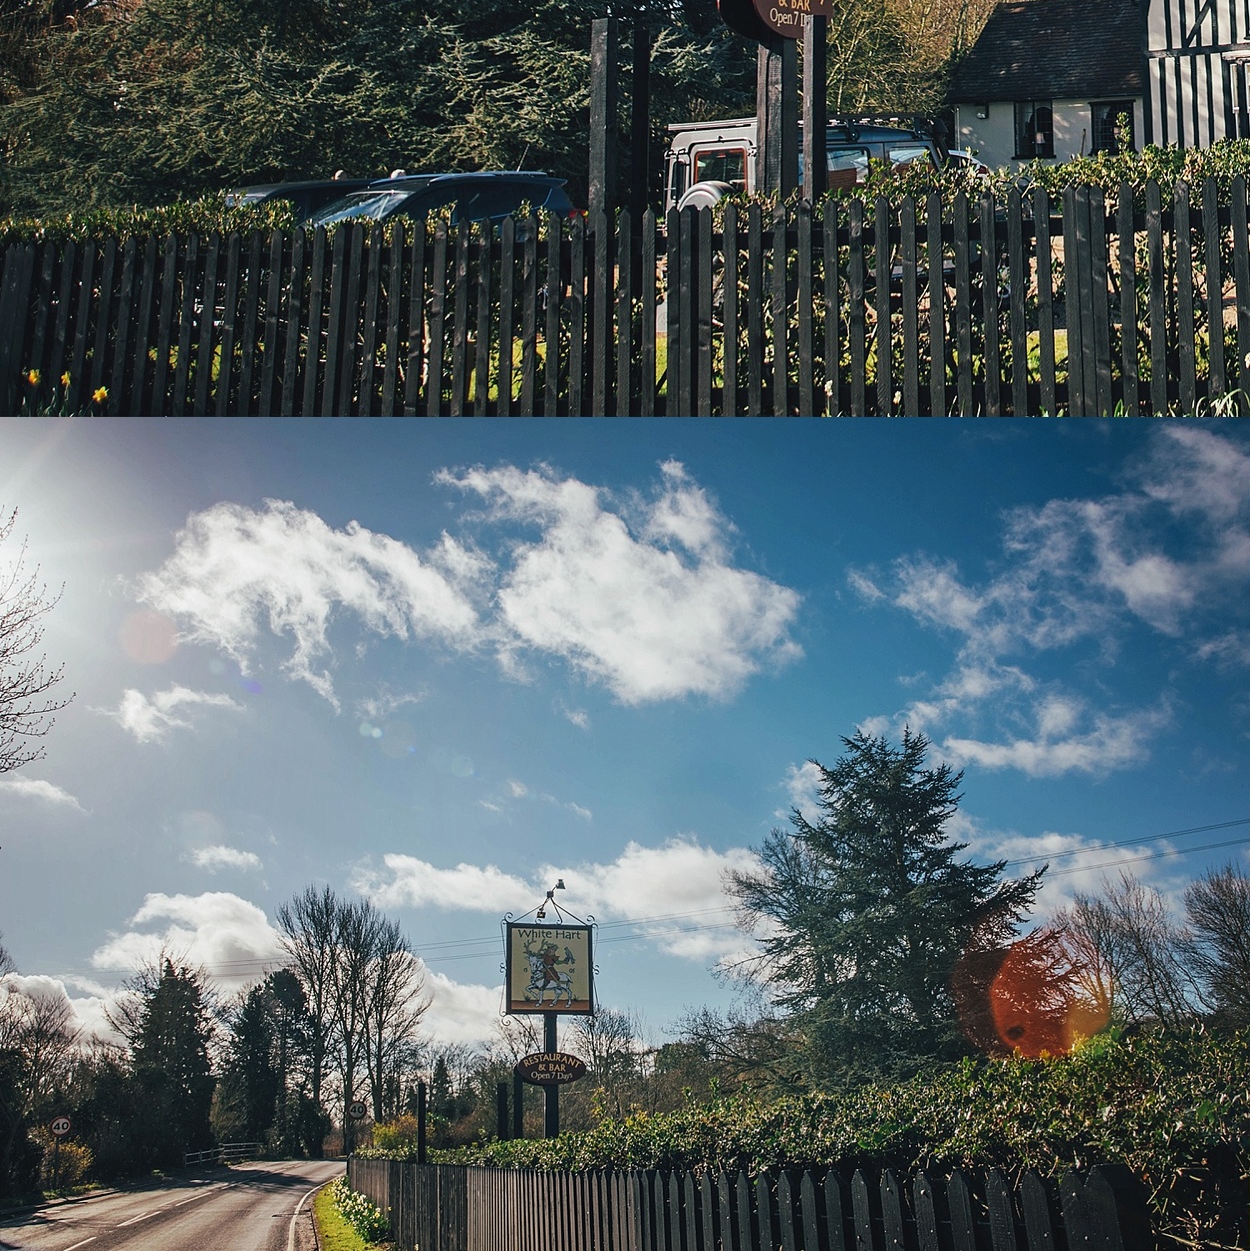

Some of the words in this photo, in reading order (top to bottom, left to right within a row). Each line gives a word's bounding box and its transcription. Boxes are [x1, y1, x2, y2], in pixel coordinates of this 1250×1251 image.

[769, 7, 793, 27] Open
[794, 11, 799, 26] 7
[518, 929, 552, 939] White
[556, 930, 581, 940] Hart
[523, 1053, 582, 1068] RESTAURANT
[538, 1063, 546, 1072] &
[549, 1063, 566, 1072] BAR
[530, 1071, 550, 1080] Open
[557, 1072, 573, 1081] Days
[350, 1105, 364, 1114] 40
[53, 1121, 69, 1131] 40
